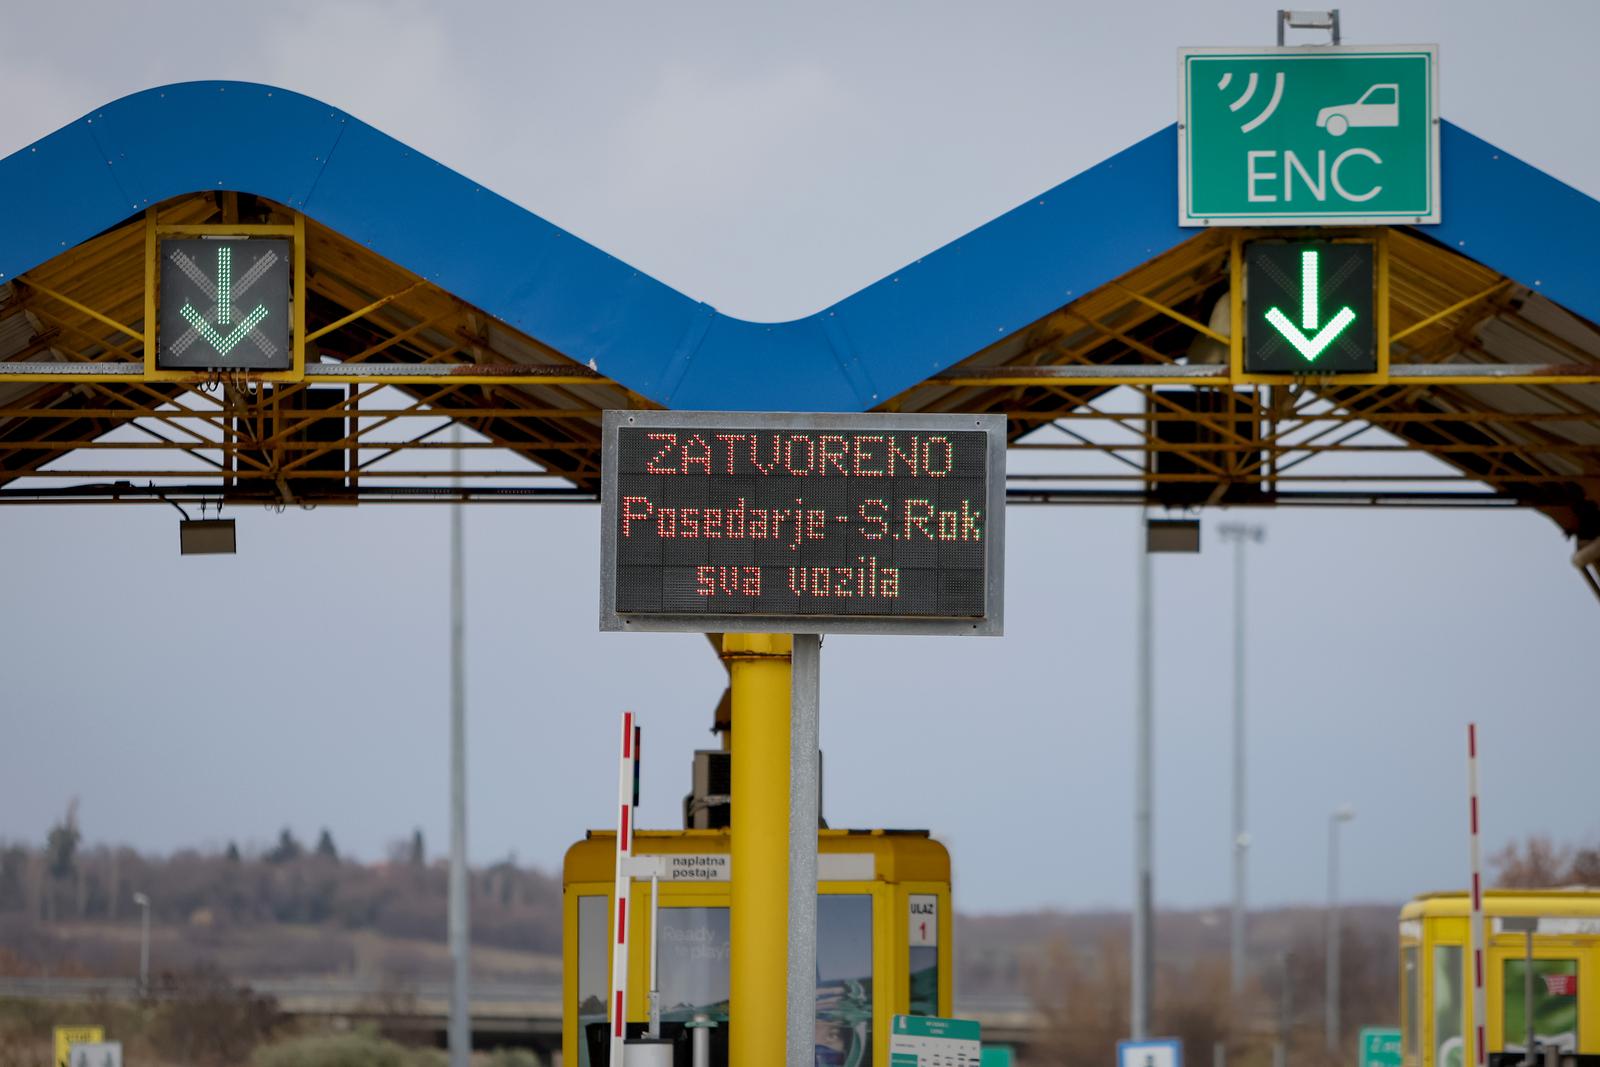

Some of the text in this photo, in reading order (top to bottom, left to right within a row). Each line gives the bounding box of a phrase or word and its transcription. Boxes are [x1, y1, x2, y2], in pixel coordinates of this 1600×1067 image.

[1248, 148, 1383, 202] ENC
[646, 432, 953, 478] ZATVORENO
[622, 495, 826, 552] Posedarje
[858, 498, 983, 541] S.Rok
[696, 556, 900, 598] sva vozila
[672, 856, 725, 867] naplatna
[672, 868, 717, 879] postaja
[910, 903, 934, 914] ULAZ
[919, 921, 927, 940] 1
